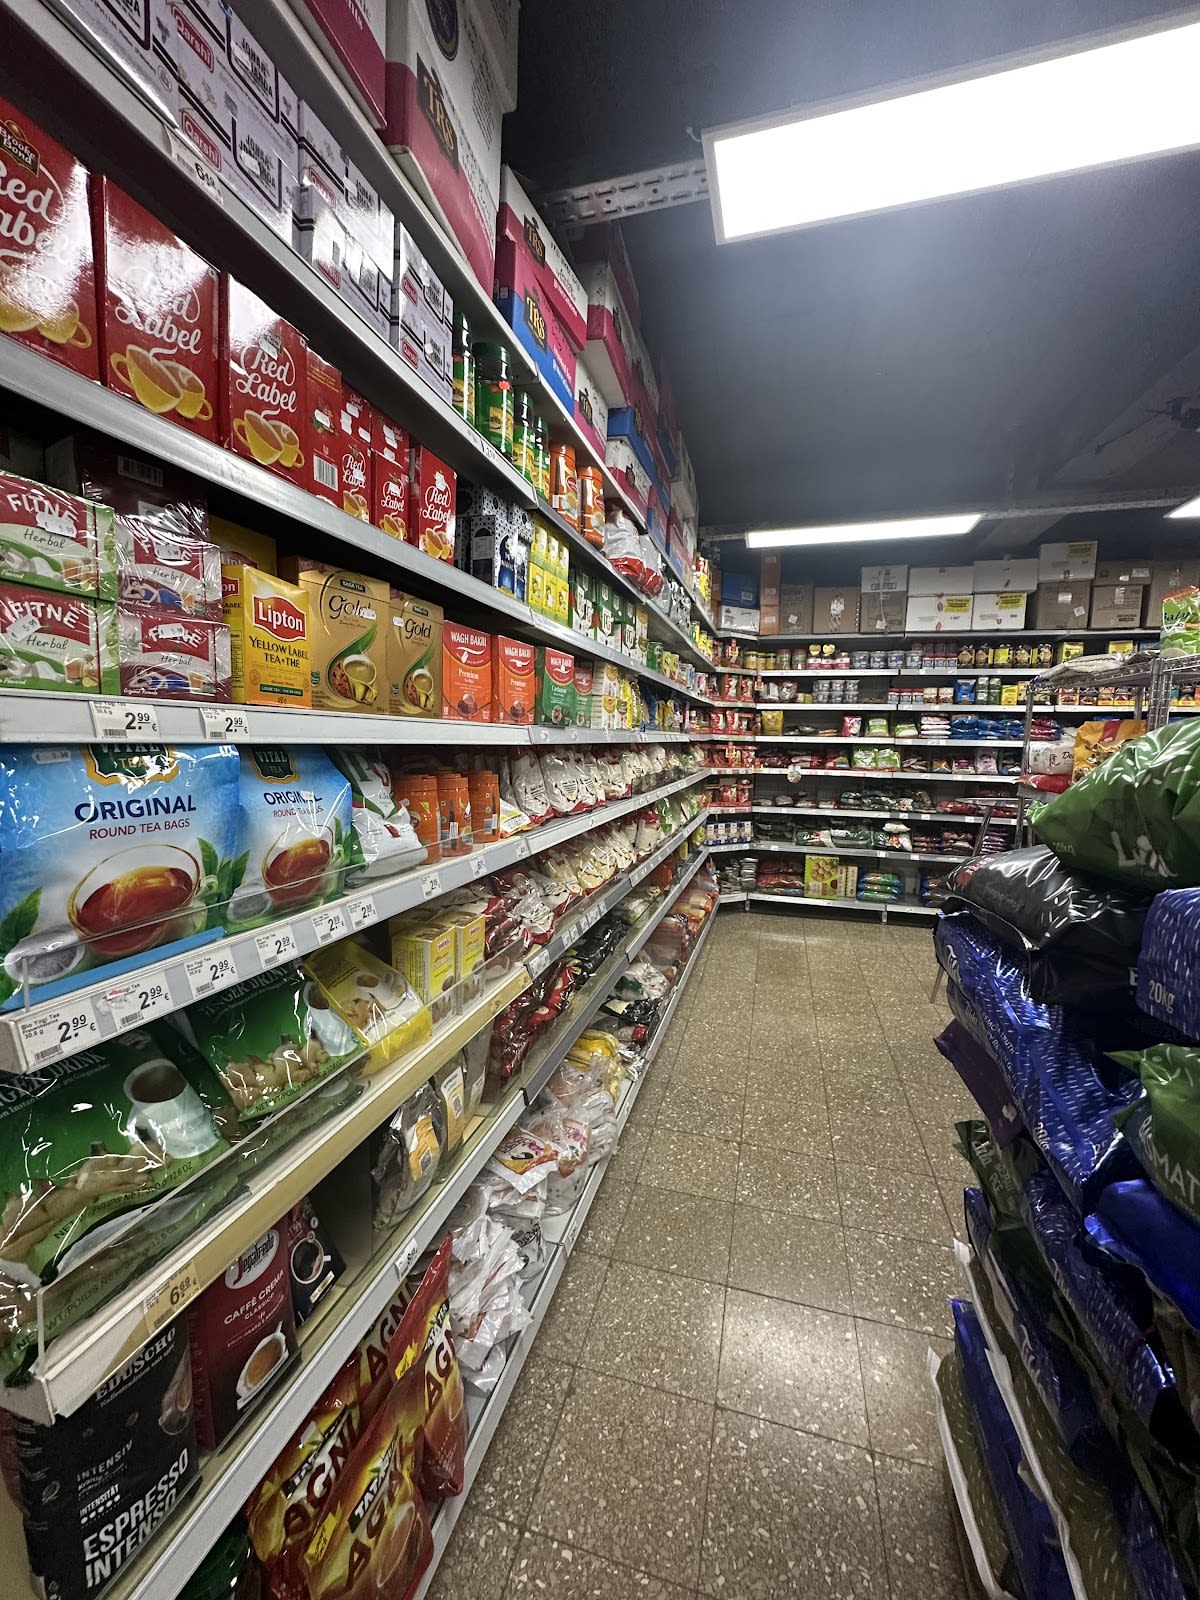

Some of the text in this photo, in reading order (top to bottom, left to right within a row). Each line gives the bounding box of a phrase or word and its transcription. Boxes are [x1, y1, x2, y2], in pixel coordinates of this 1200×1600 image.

[176, 15, 211, 66] Qarshi
[423, 75, 454, 150] TRS
[0, 126, 36, 159] Brooke
[4, 137, 32, 165] Bond
[185, 120, 219, 168] Qarshi
[526, 223, 543, 257] TRS
[526, 296, 546, 341] TRS
[115, 306, 202, 355] Label
[251, 346, 296, 387] Red
[236, 375, 297, 413] Label
[346, 454, 363, 473] Red
[381, 496, 405, 513] Label
[430, 486, 449, 507] Red
[422, 503, 451, 523] Label
[24, 528, 66, 549] Herbal
[8, 600, 80, 630] FITNE
[258, 600, 304, 633] Lipton
[405, 618, 432, 640] Gold
[451, 631, 487, 647] WAGH BAKRI
[26, 634, 69, 651] Herbal
[249, 635, 310, 661] YELLOW LABEL
[504, 646, 532, 658] WAGH BAKRI
[160, 655, 193, 667] Herbal
[264, 652, 301, 669] TEA THE
[550, 656, 562, 666] WAGH
[458, 668, 480, 680] Premium
[125, 712, 158, 732] 2.99 €
[225, 717, 244, 733] 2.99
[119, 756, 148, 769] TEA
[256, 750, 288, 764] VITAL
[269, 765, 283, 775] TEA
[263, 790, 323, 806] ORIGINL
[74, 795, 197, 824] ORIGINAL
[273, 807, 297, 818] ROUND
[89, 818, 191, 840] ROUND TEA BAGS
[275, 936, 291, 955] 2.99
[209, 960, 230, 981] 2.99
[138, 985, 170, 1011] 2.99 €
[1149, 980, 1176, 1014] 20kg
[21, 1012, 60, 1031] Bio Yogi Tea
[58, 1014, 97, 1044] 2.99 €
[170, 1276, 191, 1306] 6.69
[224, 1269, 285, 1325] CAFFÈ CREMA
[95, 1327, 176, 1401] EDUSCHO
[77, 1439, 133, 1482] INTENSIV
[83, 1447, 189, 1562] ESPRESSO
[85, 1487, 177, 1589] INTENSO
